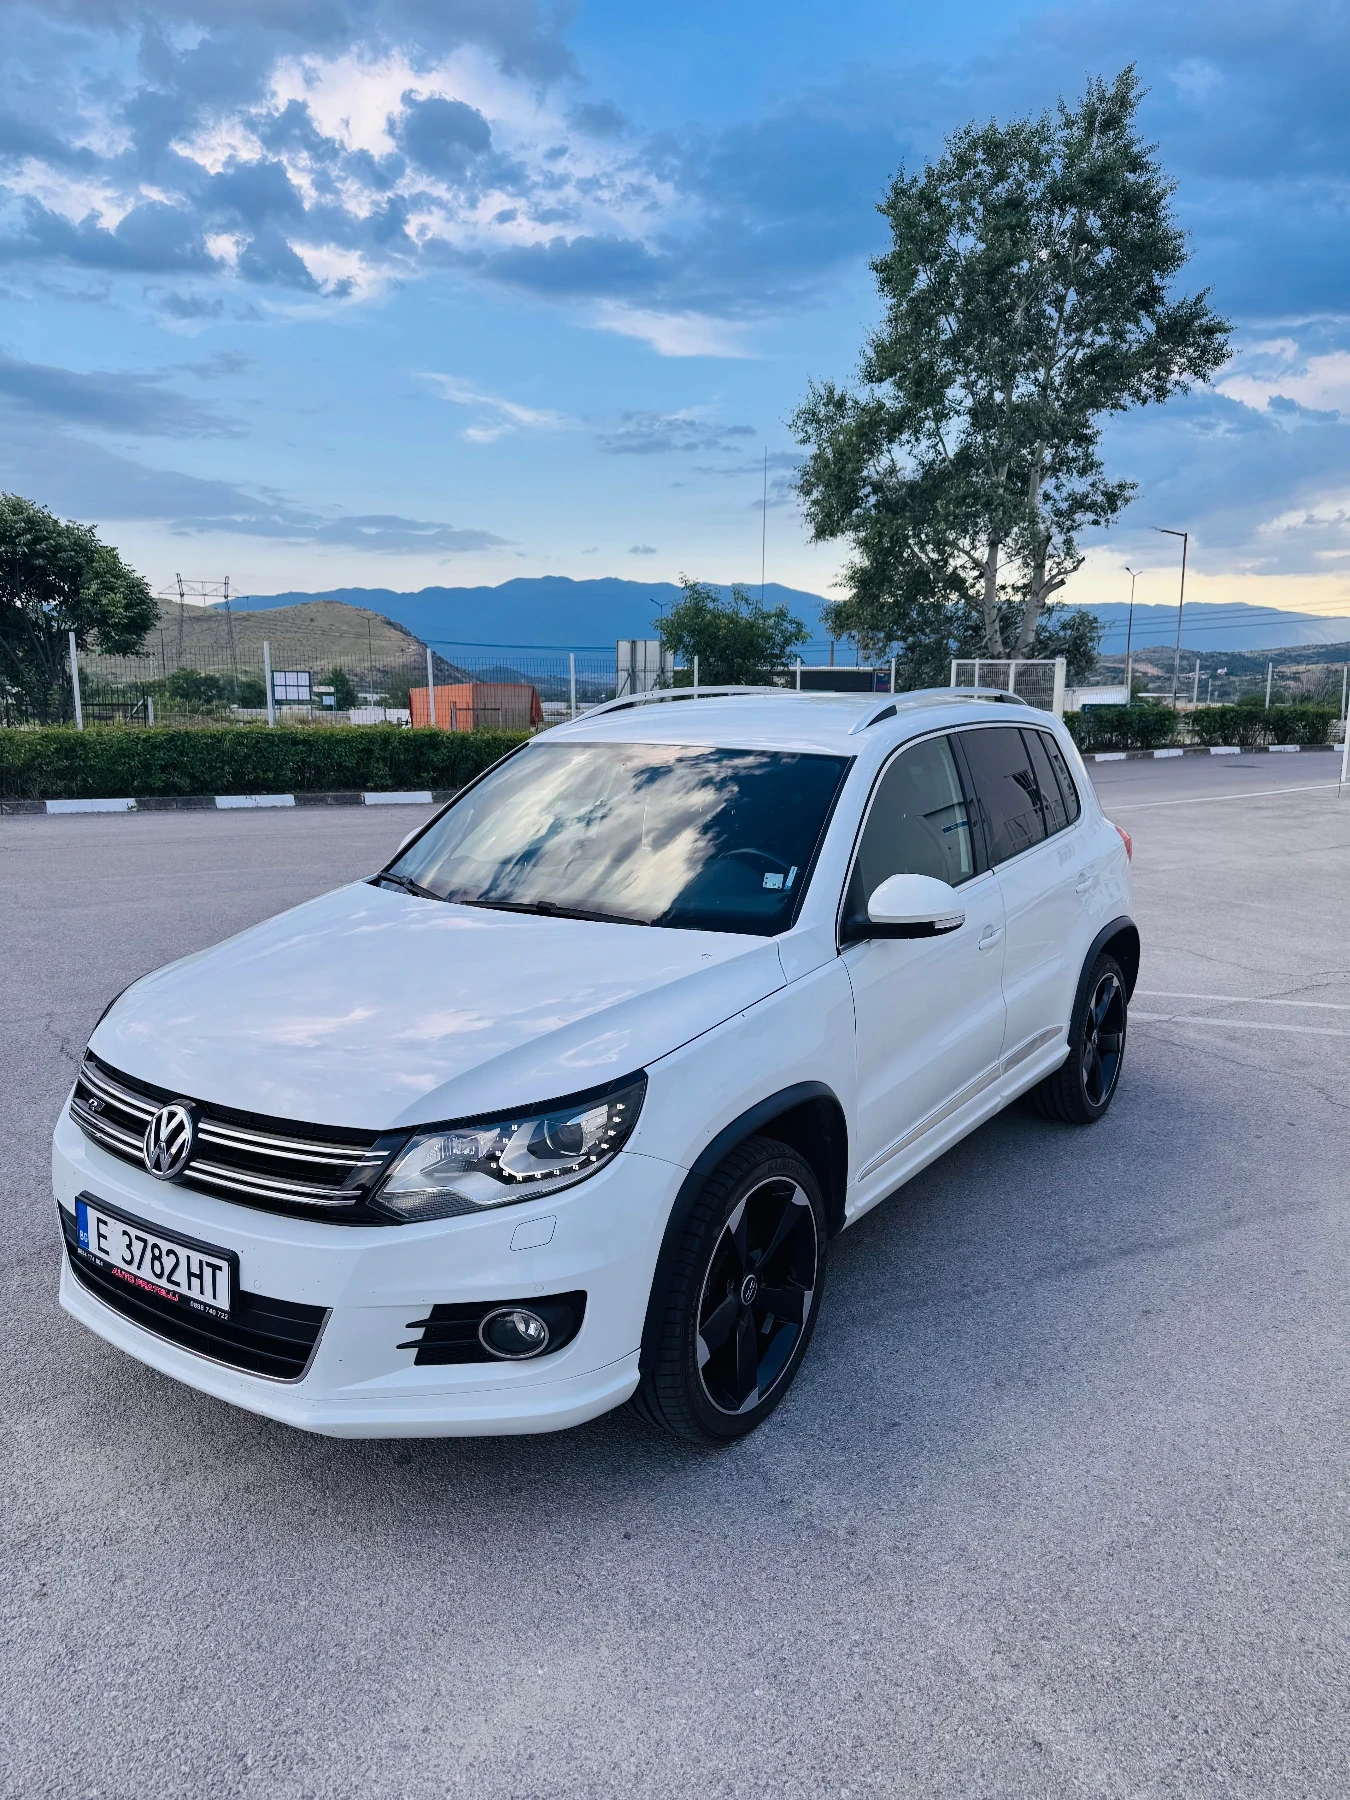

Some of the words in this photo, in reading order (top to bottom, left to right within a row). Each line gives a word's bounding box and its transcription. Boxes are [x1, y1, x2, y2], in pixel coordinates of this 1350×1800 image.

[768, 1160, 803, 1176] KUMHO
[79, 1229, 89, 1243] BG
[97, 1217, 110, 1256] E
[111, 1267, 135, 1284] AUTO
[217, 1311, 229, 1321] 722
